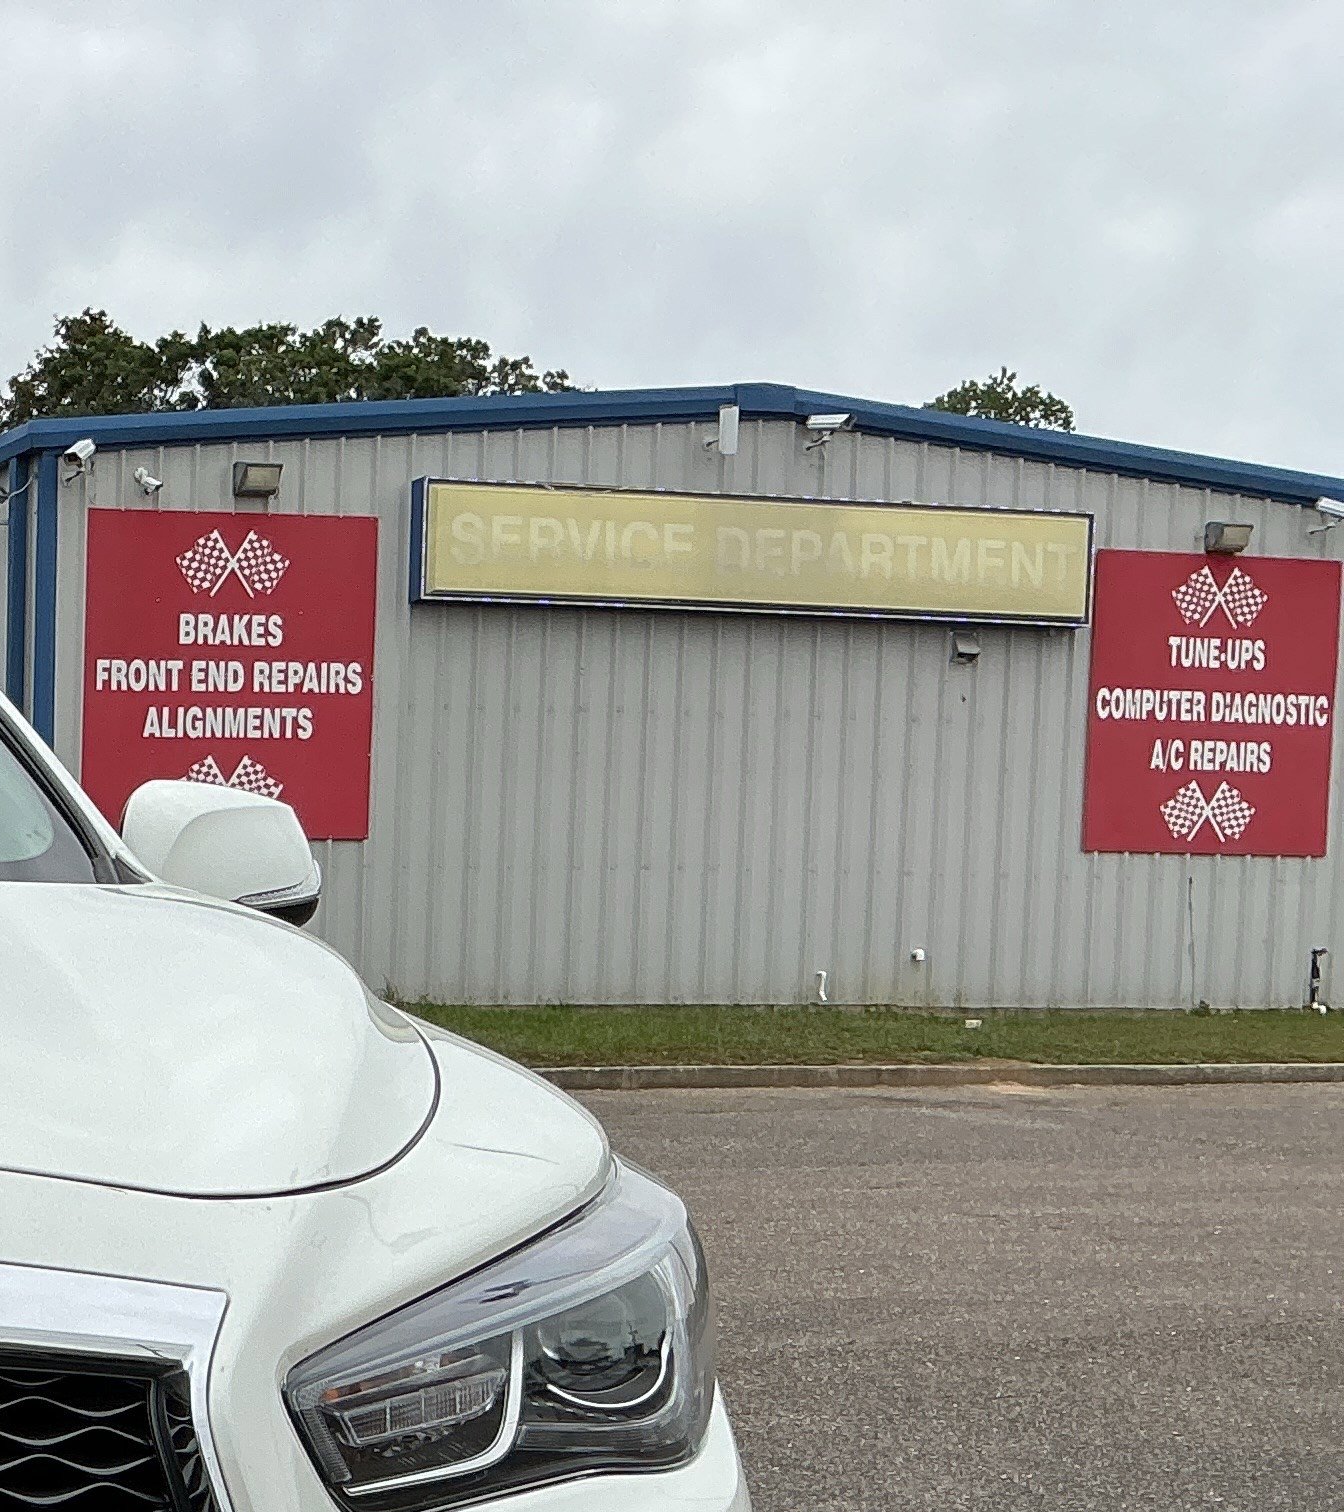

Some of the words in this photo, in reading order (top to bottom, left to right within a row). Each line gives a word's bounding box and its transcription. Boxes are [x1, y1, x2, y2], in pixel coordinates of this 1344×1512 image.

[449, 511, 696, 567] SERVICE
[715, 525, 1077, 588] DEPARTMENT
[178, 612, 284, 647] BRAKES
[1168, 635, 1266, 671] TUNE-UPS
[95, 658, 184, 692] FRONT
[190, 660, 245, 693] END
[252, 661, 363, 695] REPAIRS
[142, 705, 313, 740] ALIGNMENTS
[1095, 687, 1206, 722] COMPUTER
[1210, 691, 1330, 727] DIAGNOSTIC
[1149, 738, 1185, 773] A/C
[1188, 739, 1272, 774] REPAIRS
